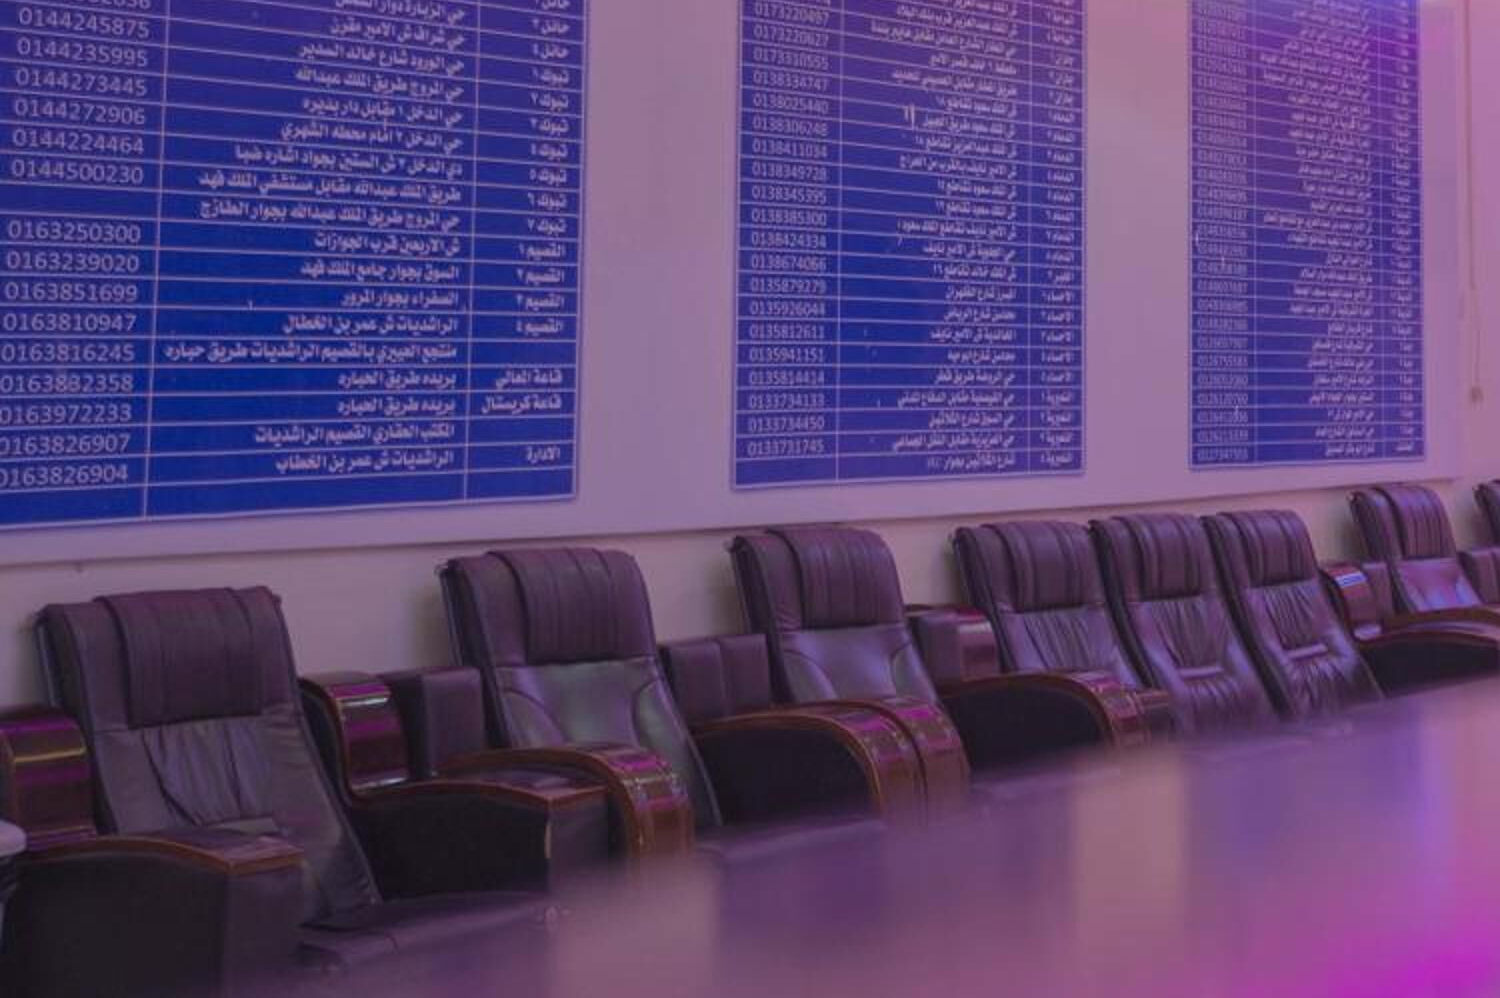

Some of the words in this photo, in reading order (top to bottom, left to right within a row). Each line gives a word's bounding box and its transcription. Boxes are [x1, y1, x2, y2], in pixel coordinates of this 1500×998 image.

[18, 6, 149, 38] 0144245875
[15, 36, 148, 67] 0144235995
[14, 66, 147, 96] 0144273445
[13, 96, 146, 125] 0144272906
[12, 127, 144, 154] 0144224464
[10, 158, 144, 184] 0144500230
[6, 219, 141, 243] 0163250300
[5, 250, 139, 273] 0163239020
[3, 281, 138, 303] 0163851699
[2, 312, 137, 332] 0163810947
[0, 342, 135, 362] 0163816245
[0, 402, 132, 425] 0163972233
